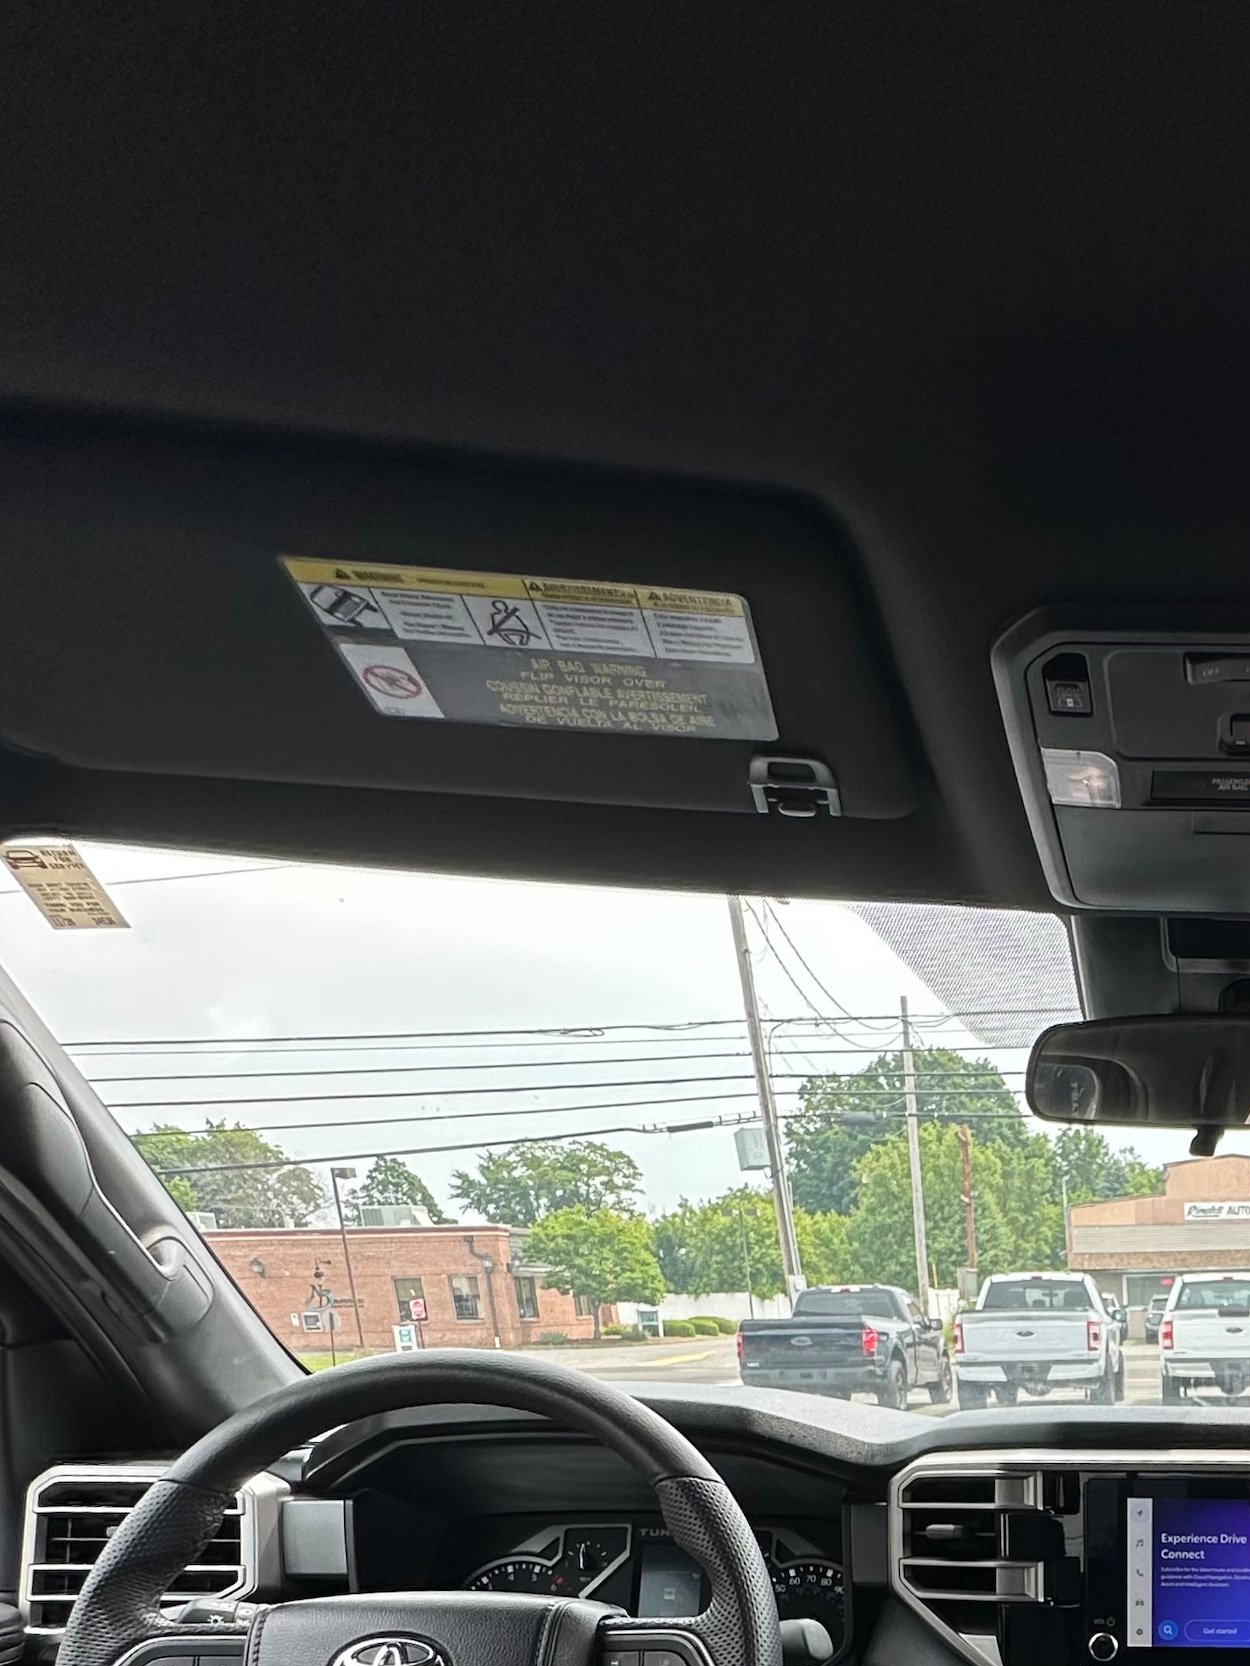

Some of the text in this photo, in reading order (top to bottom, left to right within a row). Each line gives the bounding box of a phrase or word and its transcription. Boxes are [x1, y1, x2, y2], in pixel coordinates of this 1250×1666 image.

[531, 658, 648, 677] AIR BAG WARNING
[520, 671, 666, 689] FLIP VISOR OVER
[486, 680, 540, 694] COUSSIN
[544, 683, 614, 699] GONFLABLE
[502, 692, 568, 704] REPLIER
[579, 697, 598, 706] LE
[500, 703, 578, 719] ADVERTENCIA
[653, 720, 698, 732] VISOR
[638, 1528, 674, 1537] TUN
[1161, 1532, 1247, 1545] Experience Drive
[1160, 1549, 1205, 1560] Connect
[775, 1584, 786, 1593] 50
[789, 1577, 800, 1585] 60
[806, 1575, 817, 1583] 70
[821, 1578, 832, 1587] 80
[1203, 1627, 1238, 1635] Get started
